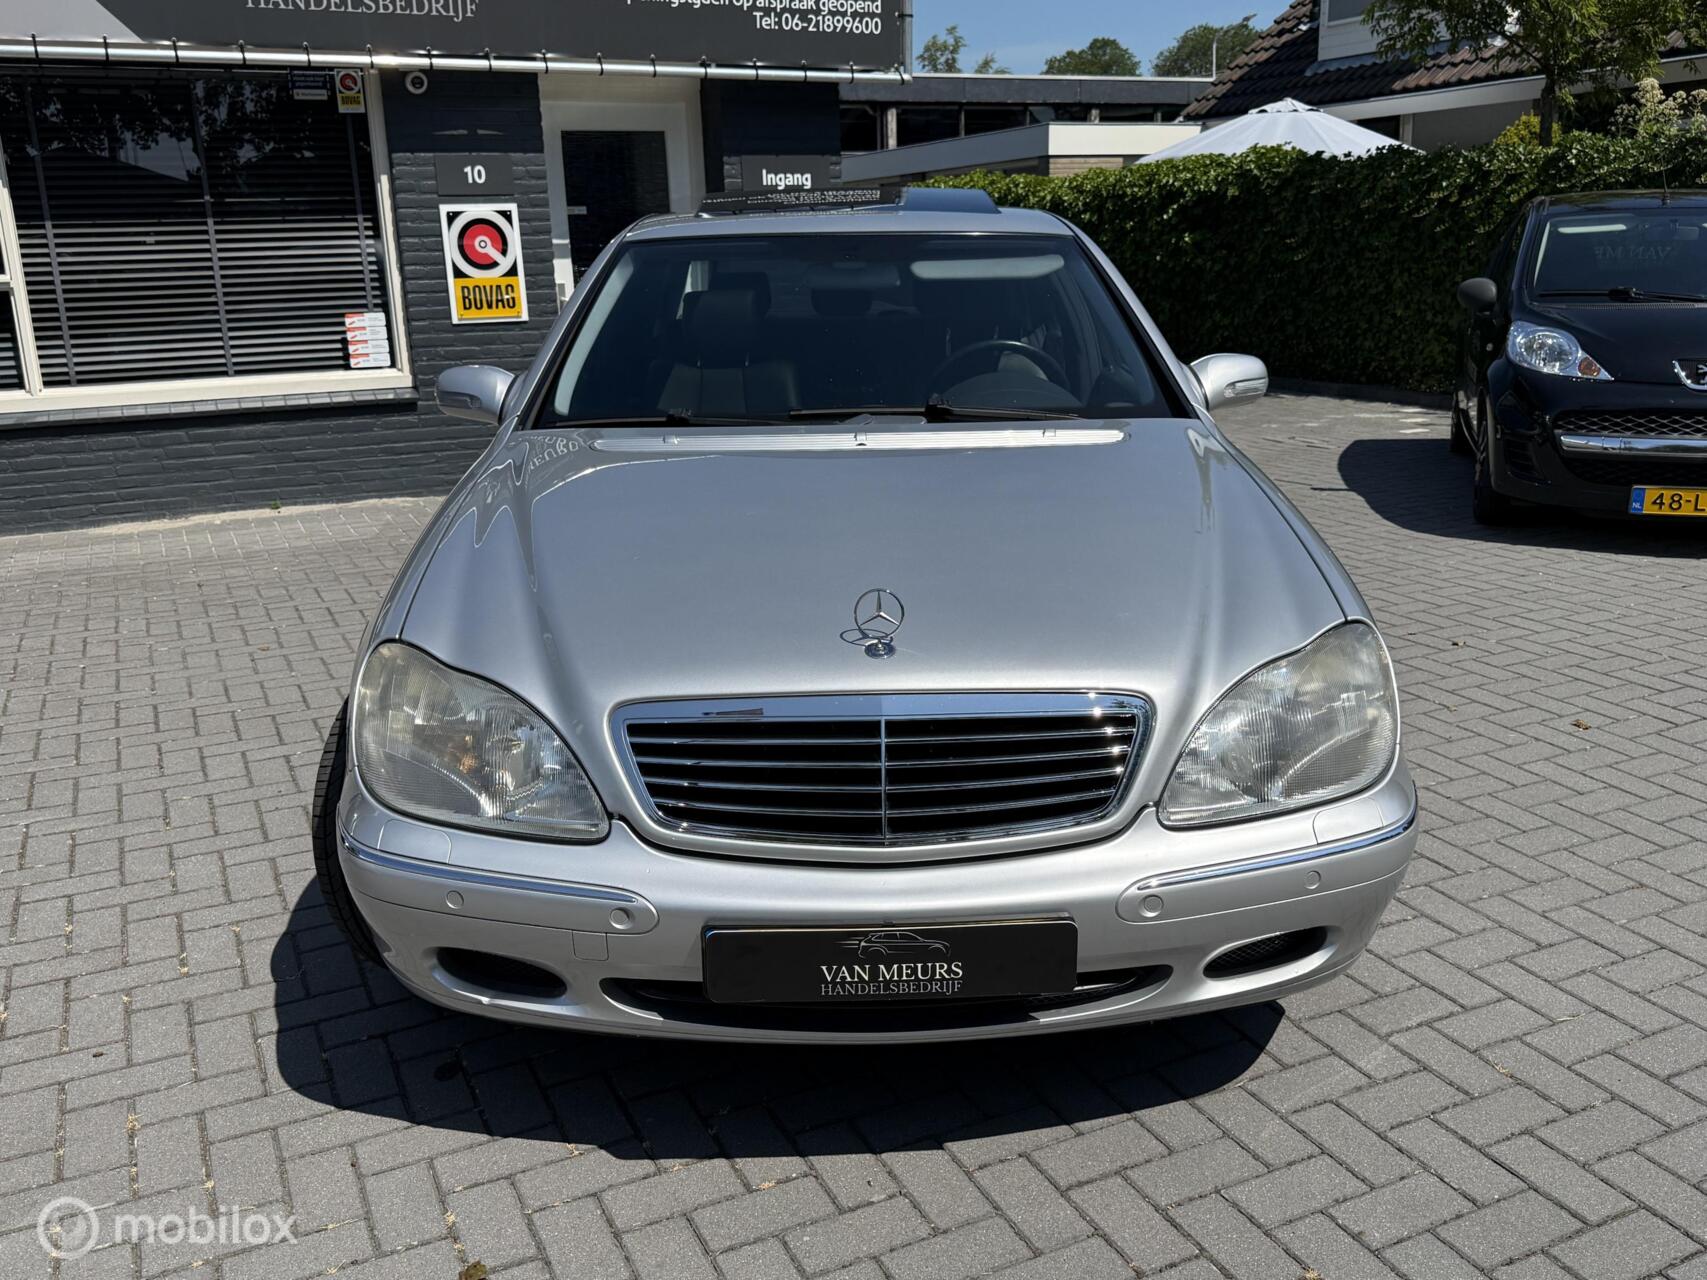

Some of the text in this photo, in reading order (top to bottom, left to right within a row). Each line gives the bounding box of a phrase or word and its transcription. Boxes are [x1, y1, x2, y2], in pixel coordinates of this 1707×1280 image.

[820, 0, 881, 16] geopend
[753, 12, 881, 34] Tel: 06-21899600
[463, 165, 486, 184] 10
[762, 168, 812, 190] Ingang
[460, 283, 516, 311] BOVAG
[820, 961, 963, 982] VAN MEURS
[820, 980, 963, 996] HANDELSBEDRIJF
